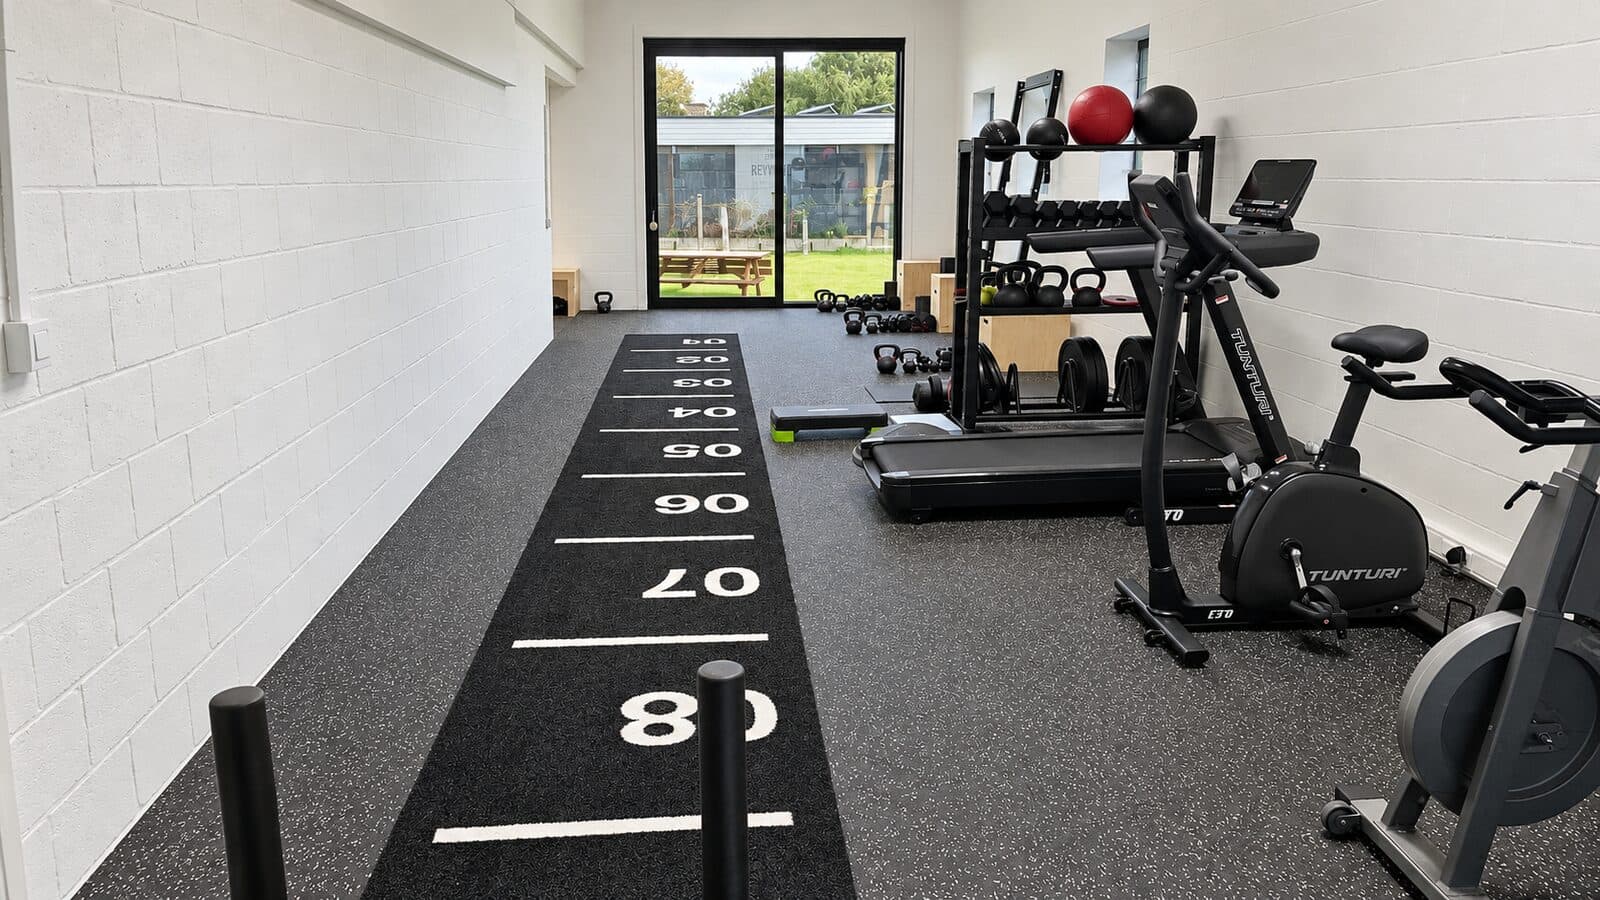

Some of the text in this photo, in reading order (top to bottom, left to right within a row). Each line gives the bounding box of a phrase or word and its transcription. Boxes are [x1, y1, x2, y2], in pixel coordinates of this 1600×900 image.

[675, 355, 729, 364] 02
[1231, 328, 1273, 416] TUNTURI
[672, 378, 733, 388] 03
[668, 406, 737, 418] 04
[662, 443, 742, 458] 05
[654, 493, 750, 514] 06
[641, 566, 761, 598] 07
[1309, 567, 1402, 582] TUNTURI
